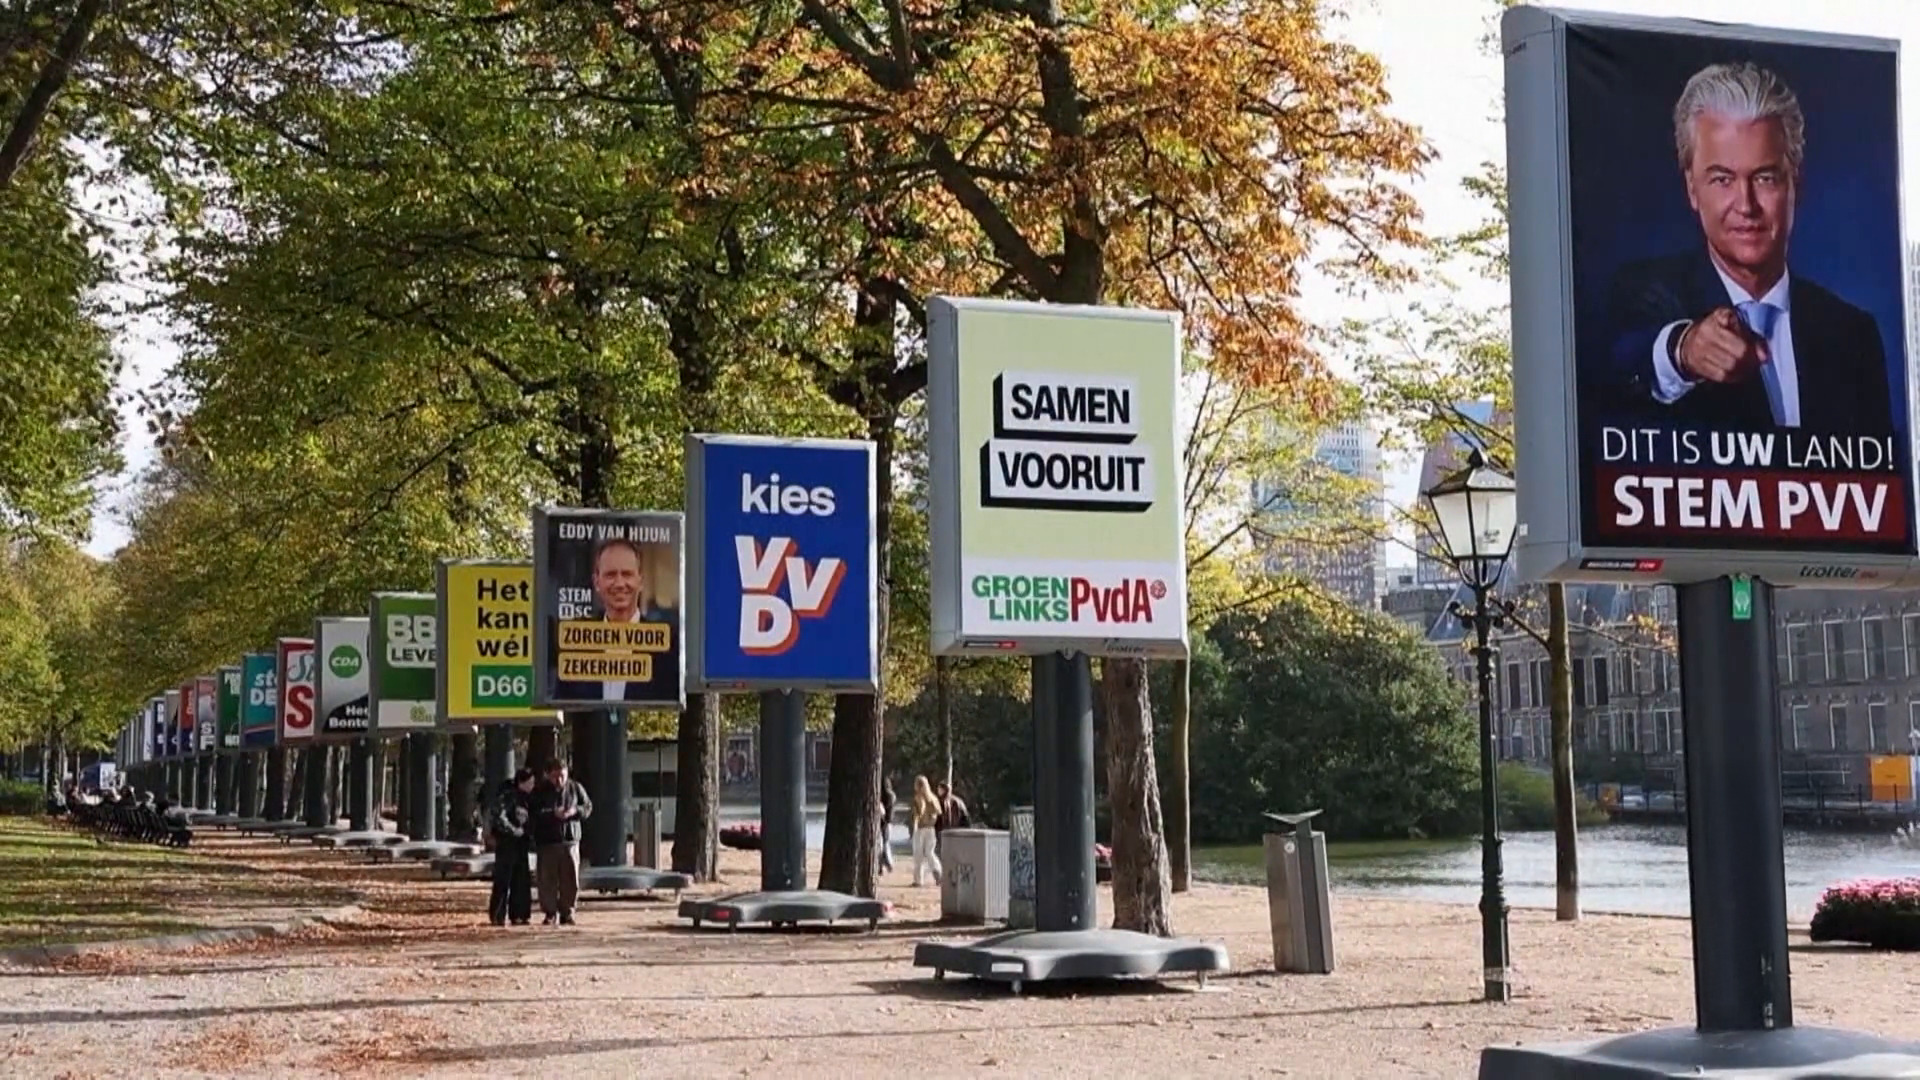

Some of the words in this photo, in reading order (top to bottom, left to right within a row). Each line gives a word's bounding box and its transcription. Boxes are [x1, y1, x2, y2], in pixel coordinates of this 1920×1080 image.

[1011, 383, 1130, 424] SAMEN
[1603, 427, 1660, 462] DIT
[1673, 430, 1700, 465] IS
[1711, 432, 1775, 467] UW
[1787, 434, 1894, 470] LAND!
[998, 452, 1145, 492] VOORUIT
[742, 473, 836, 516] kies
[1614, 475, 1764, 529] STEM
[1778, 481, 1888, 533] PVV
[559, 523, 594, 539] EDDY
[599, 525, 625, 541] VAN
[629, 528, 670, 543] HIJUM
[1800, 565, 1859, 578] trotter
[477, 578, 530, 602] Het
[558, 587, 592, 602] STEM
[972, 576, 1069, 598] GROEN
[989, 599, 1069, 622] LINKS
[1071, 577, 1153, 623] PvdA
[477, 607, 529, 630] kan
[477, 634, 529, 658] wél
[563, 628, 620, 645] ZORGEN
[625, 629, 665, 646] VOOR
[331, 657, 359, 667] CDA
[563, 659, 648, 676] ZEKERHEID!
[477, 675, 527, 697] D66
